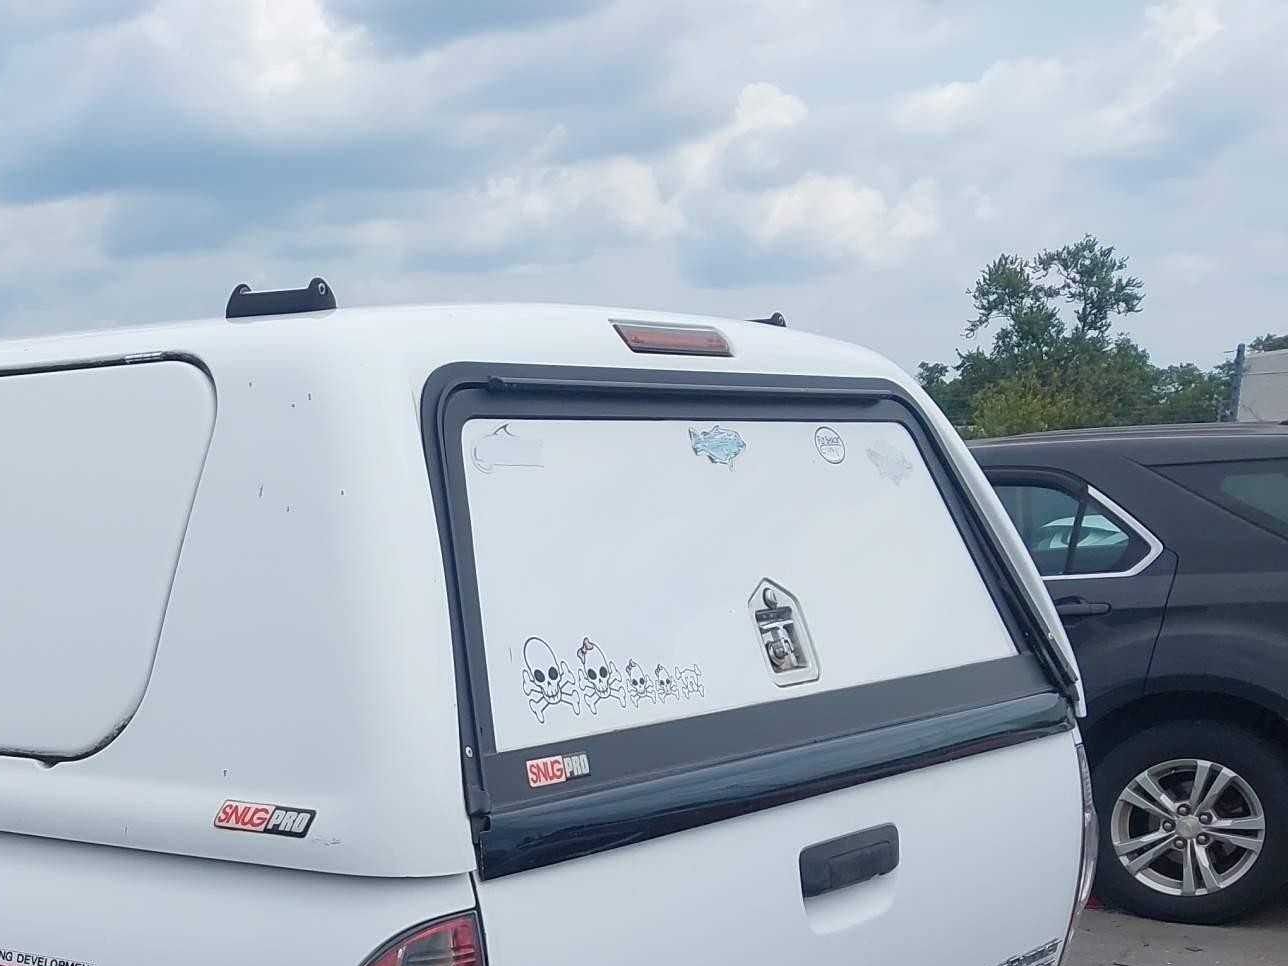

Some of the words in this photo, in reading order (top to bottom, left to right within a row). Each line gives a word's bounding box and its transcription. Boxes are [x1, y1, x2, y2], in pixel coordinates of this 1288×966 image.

[529, 760, 563, 784] SNUG
[563, 754, 590, 778] PRO
[217, 804, 270, 827] SNUG
[266, 809, 311, 833] PRO
